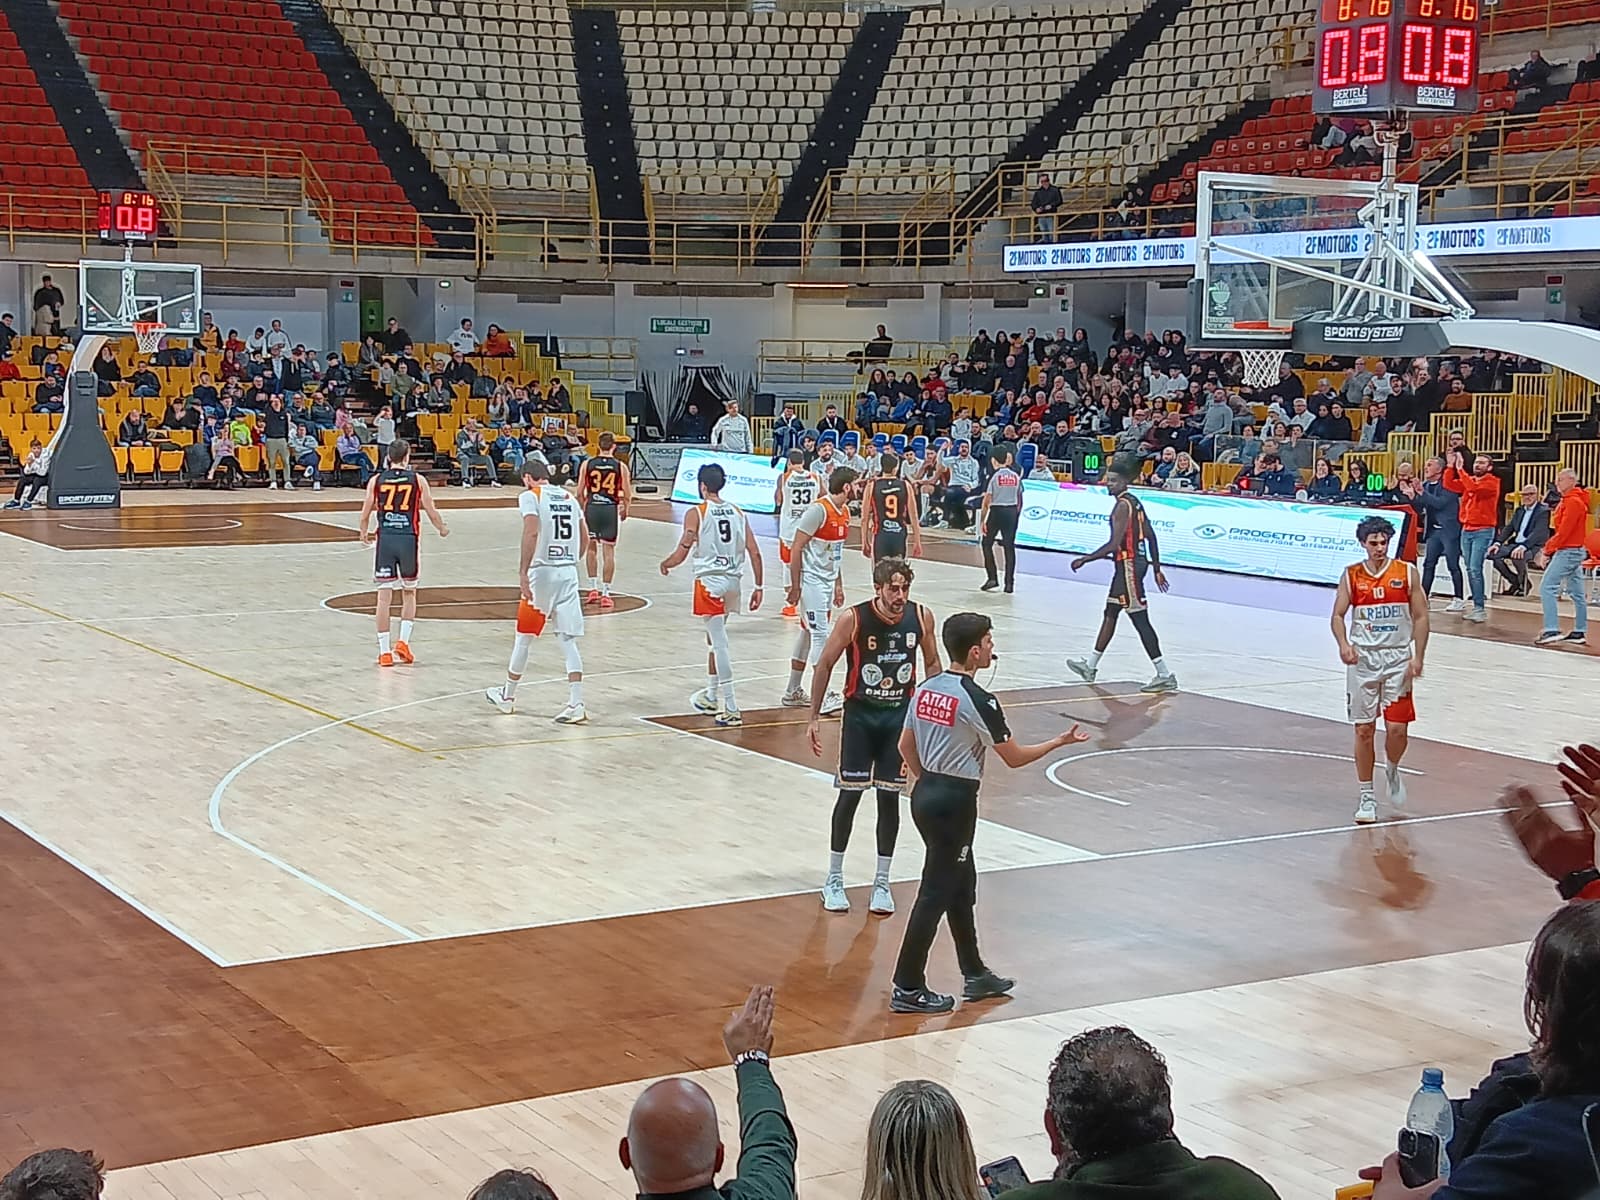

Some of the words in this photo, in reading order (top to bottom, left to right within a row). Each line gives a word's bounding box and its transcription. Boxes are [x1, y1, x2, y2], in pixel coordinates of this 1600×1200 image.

[123, 193, 154, 206] 8:16
[116, 206, 153, 231] 0.8
[1324, 326, 1404, 340] SPORTSYSTEM
[1084, 455, 1098, 469] 00
[590, 470, 616, 495] 34
[1367, 473, 1384, 491] 00
[380, 484, 413, 511] 77
[791, 489, 811, 505] 33
[885, 494, 898, 519] 9
[551, 514, 572, 540] 15
[718, 519, 732, 543] 9
[1229, 527, 1306, 542] PROGETTO
[1372, 586, 1385, 600] 10
[867, 635, 877, 650] 6
[920, 692, 953, 710] ATTAL
[918, 704, 952, 720] GROUP
